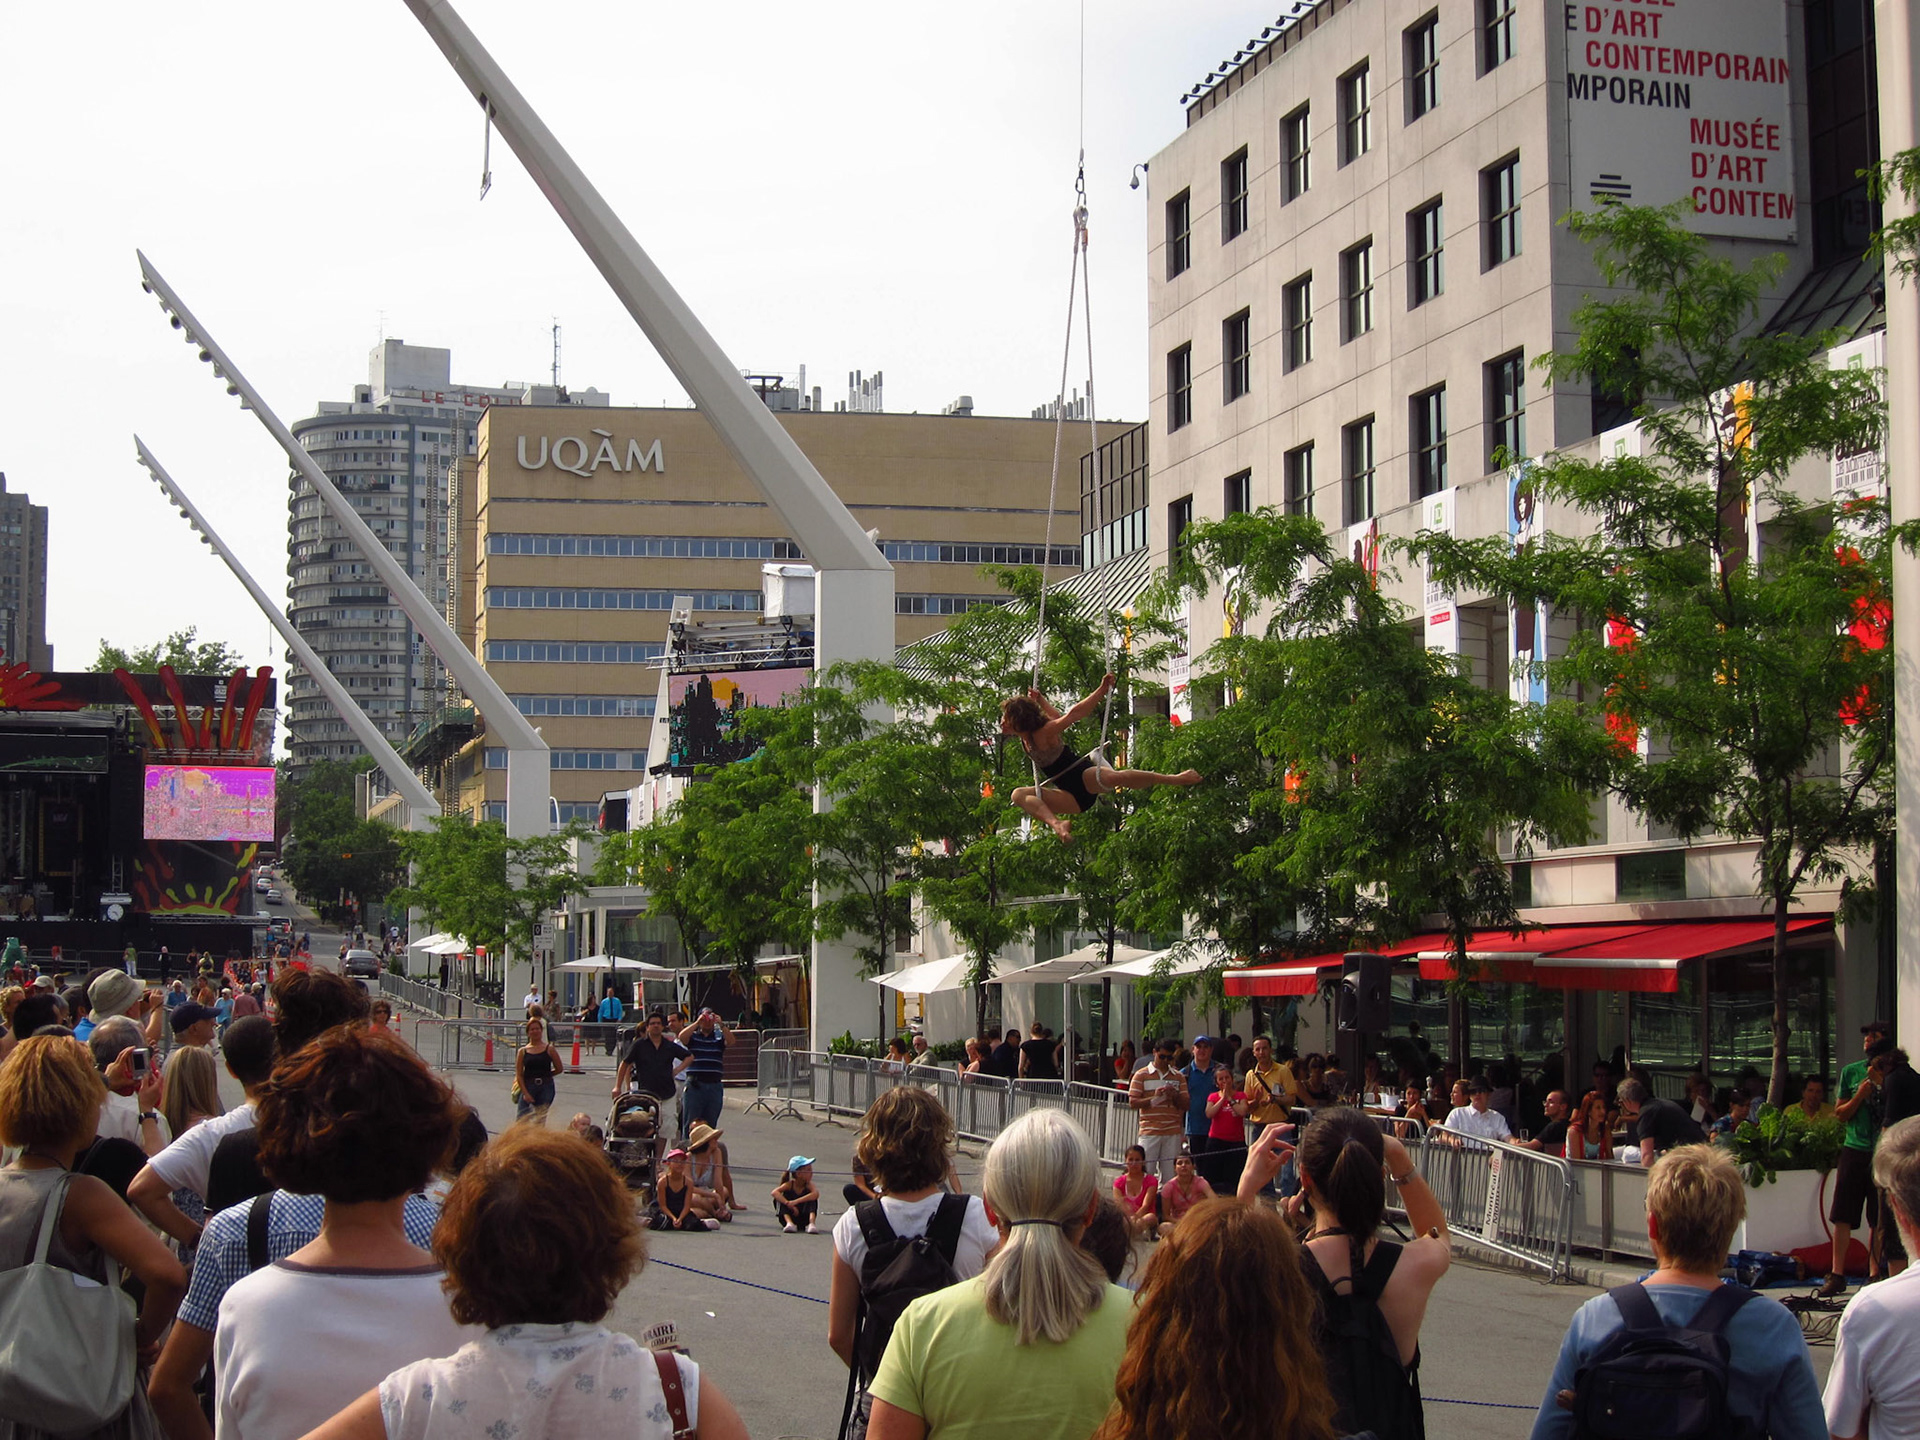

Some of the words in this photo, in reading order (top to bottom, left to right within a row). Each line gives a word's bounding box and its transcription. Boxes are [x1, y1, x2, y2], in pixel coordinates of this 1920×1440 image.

[1585, 6, 1663, 39] D'ART
[1585, 40, 1790, 84] CONTEMPORAIN
[1568, 73, 1691, 109] MPORAIN
[1690, 117, 1780, 151] MUSÉE
[1691, 152, 1768, 184] D'ART
[1692, 186, 1794, 220] CONTEM
[422, 391, 444, 404] LE
[517, 428, 664, 477] UQÀM
